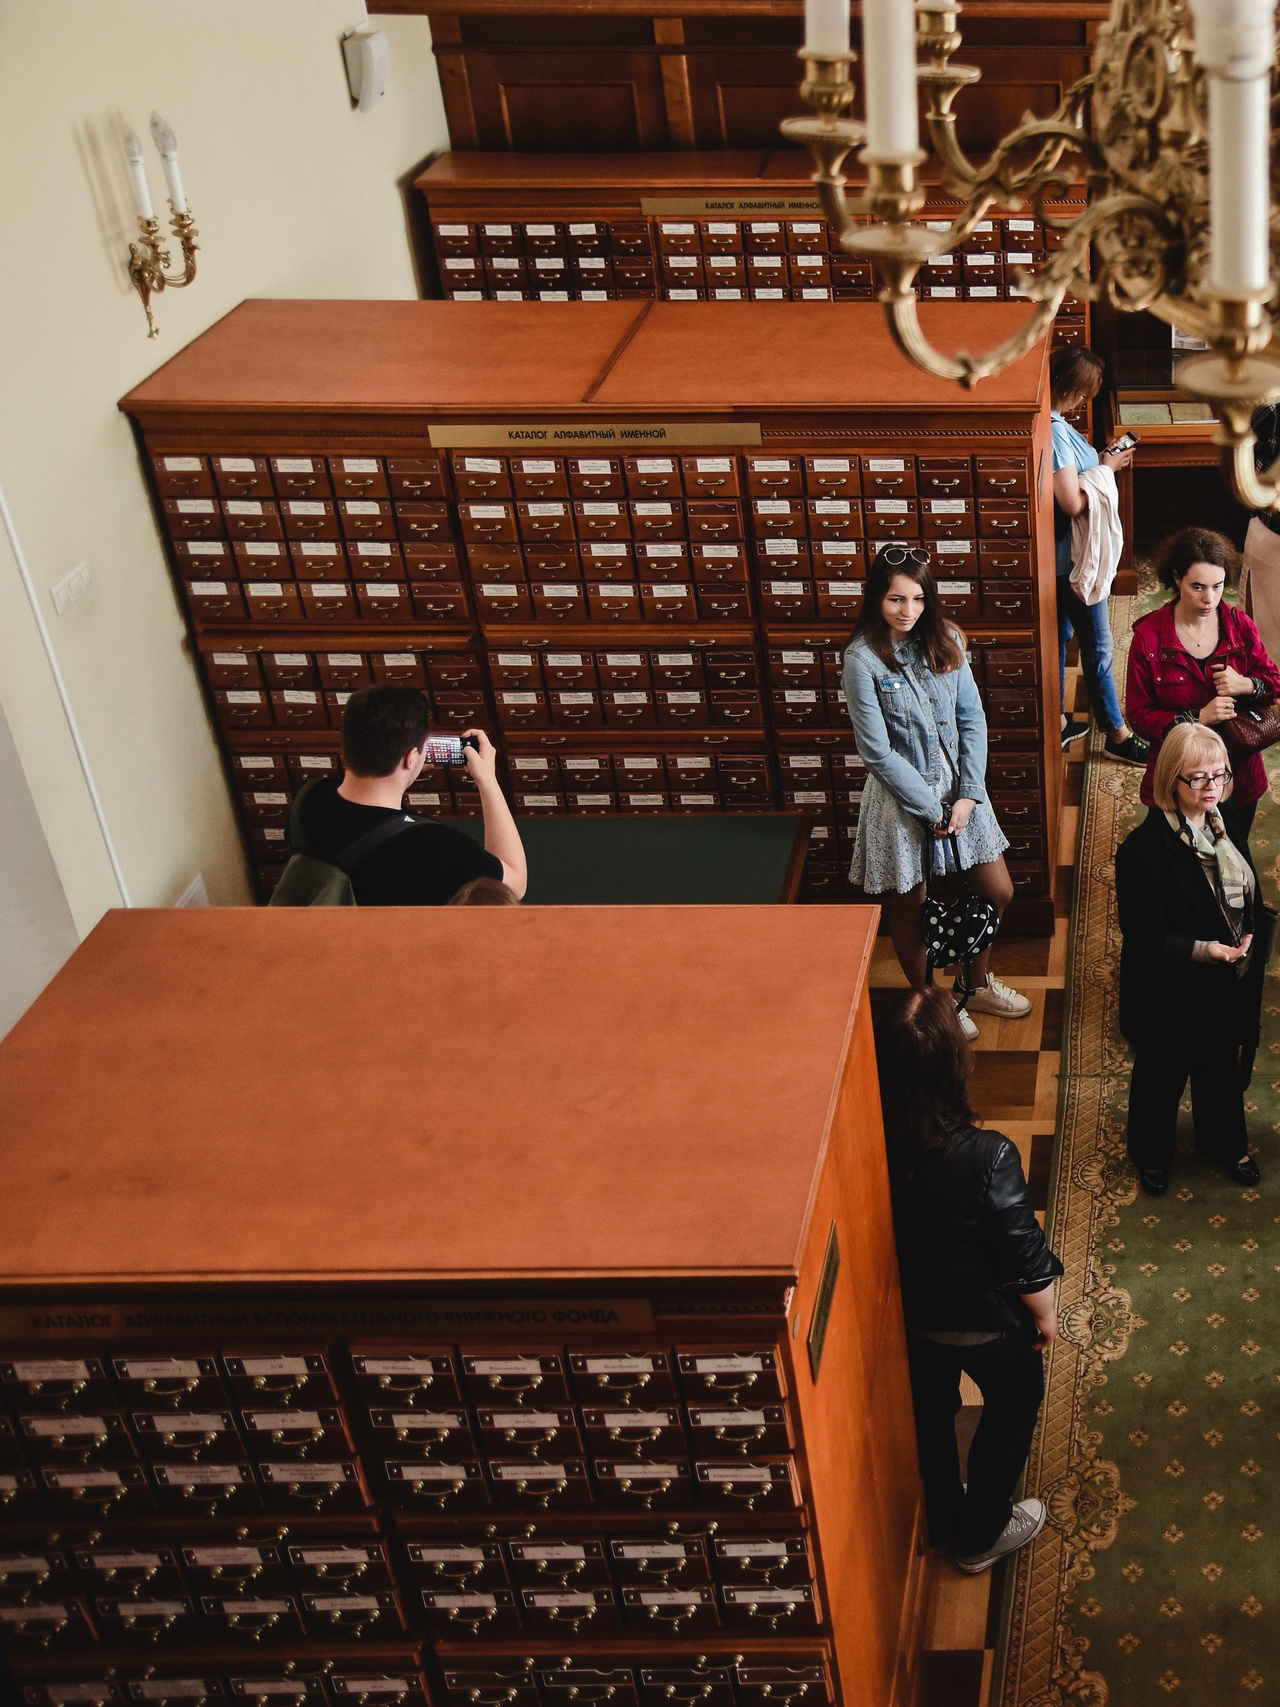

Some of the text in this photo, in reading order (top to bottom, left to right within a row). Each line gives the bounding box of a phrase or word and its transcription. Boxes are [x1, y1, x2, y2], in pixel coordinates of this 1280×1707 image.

[704, 202, 735, 210] КАТАЛОГ
[739, 201, 785, 210] АЛФАВИТНЫЙ
[508, 428, 667, 440] КАТАЛОГ АЛФАВИТНЫЙ ИМЕННОЙ
[31, 1308, 620, 1329] КАТАЛОГ АЛФАВИТНЫЙ ВСПОМОГАТЕЛЬНОГО КНИЖНОГО ФОНДА
